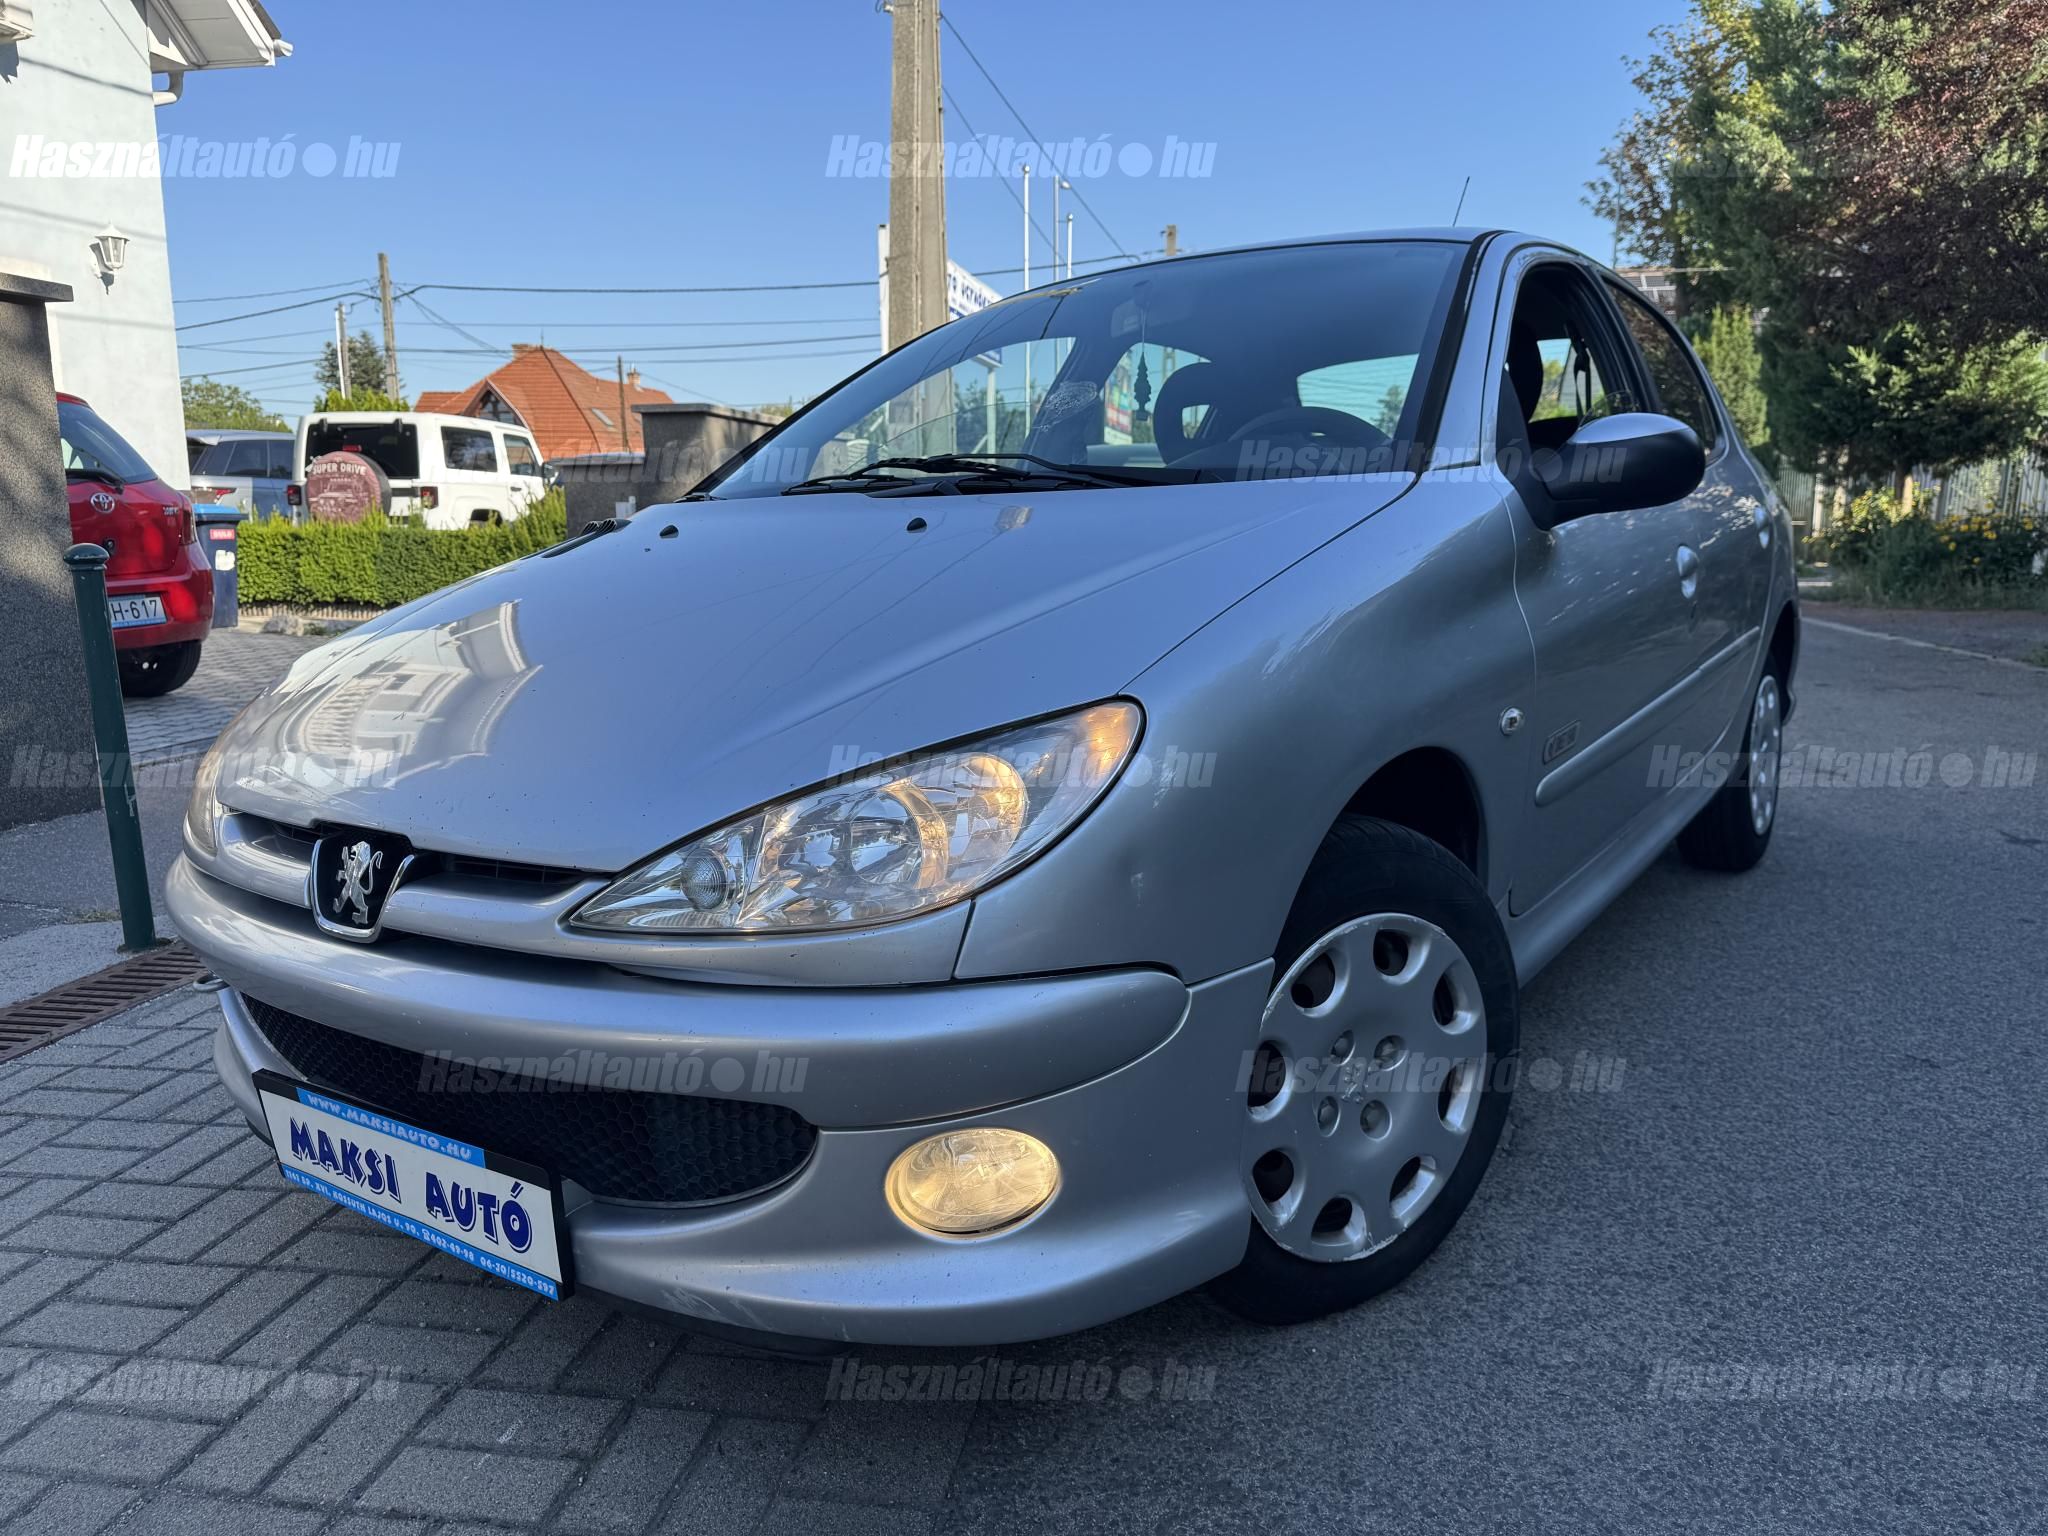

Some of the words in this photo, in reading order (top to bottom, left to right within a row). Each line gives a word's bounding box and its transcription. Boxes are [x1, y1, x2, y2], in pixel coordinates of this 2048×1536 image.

[312, 463, 337, 475] SUPER
[340, 463, 367, 475] DRIVE
[289, 1117, 402, 1203] MAKSI
[425, 1171, 533, 1254] AUTÓ
[333, 1189, 367, 1214] KOSSUTH
[367, 1205, 392, 1225] LAJOS
